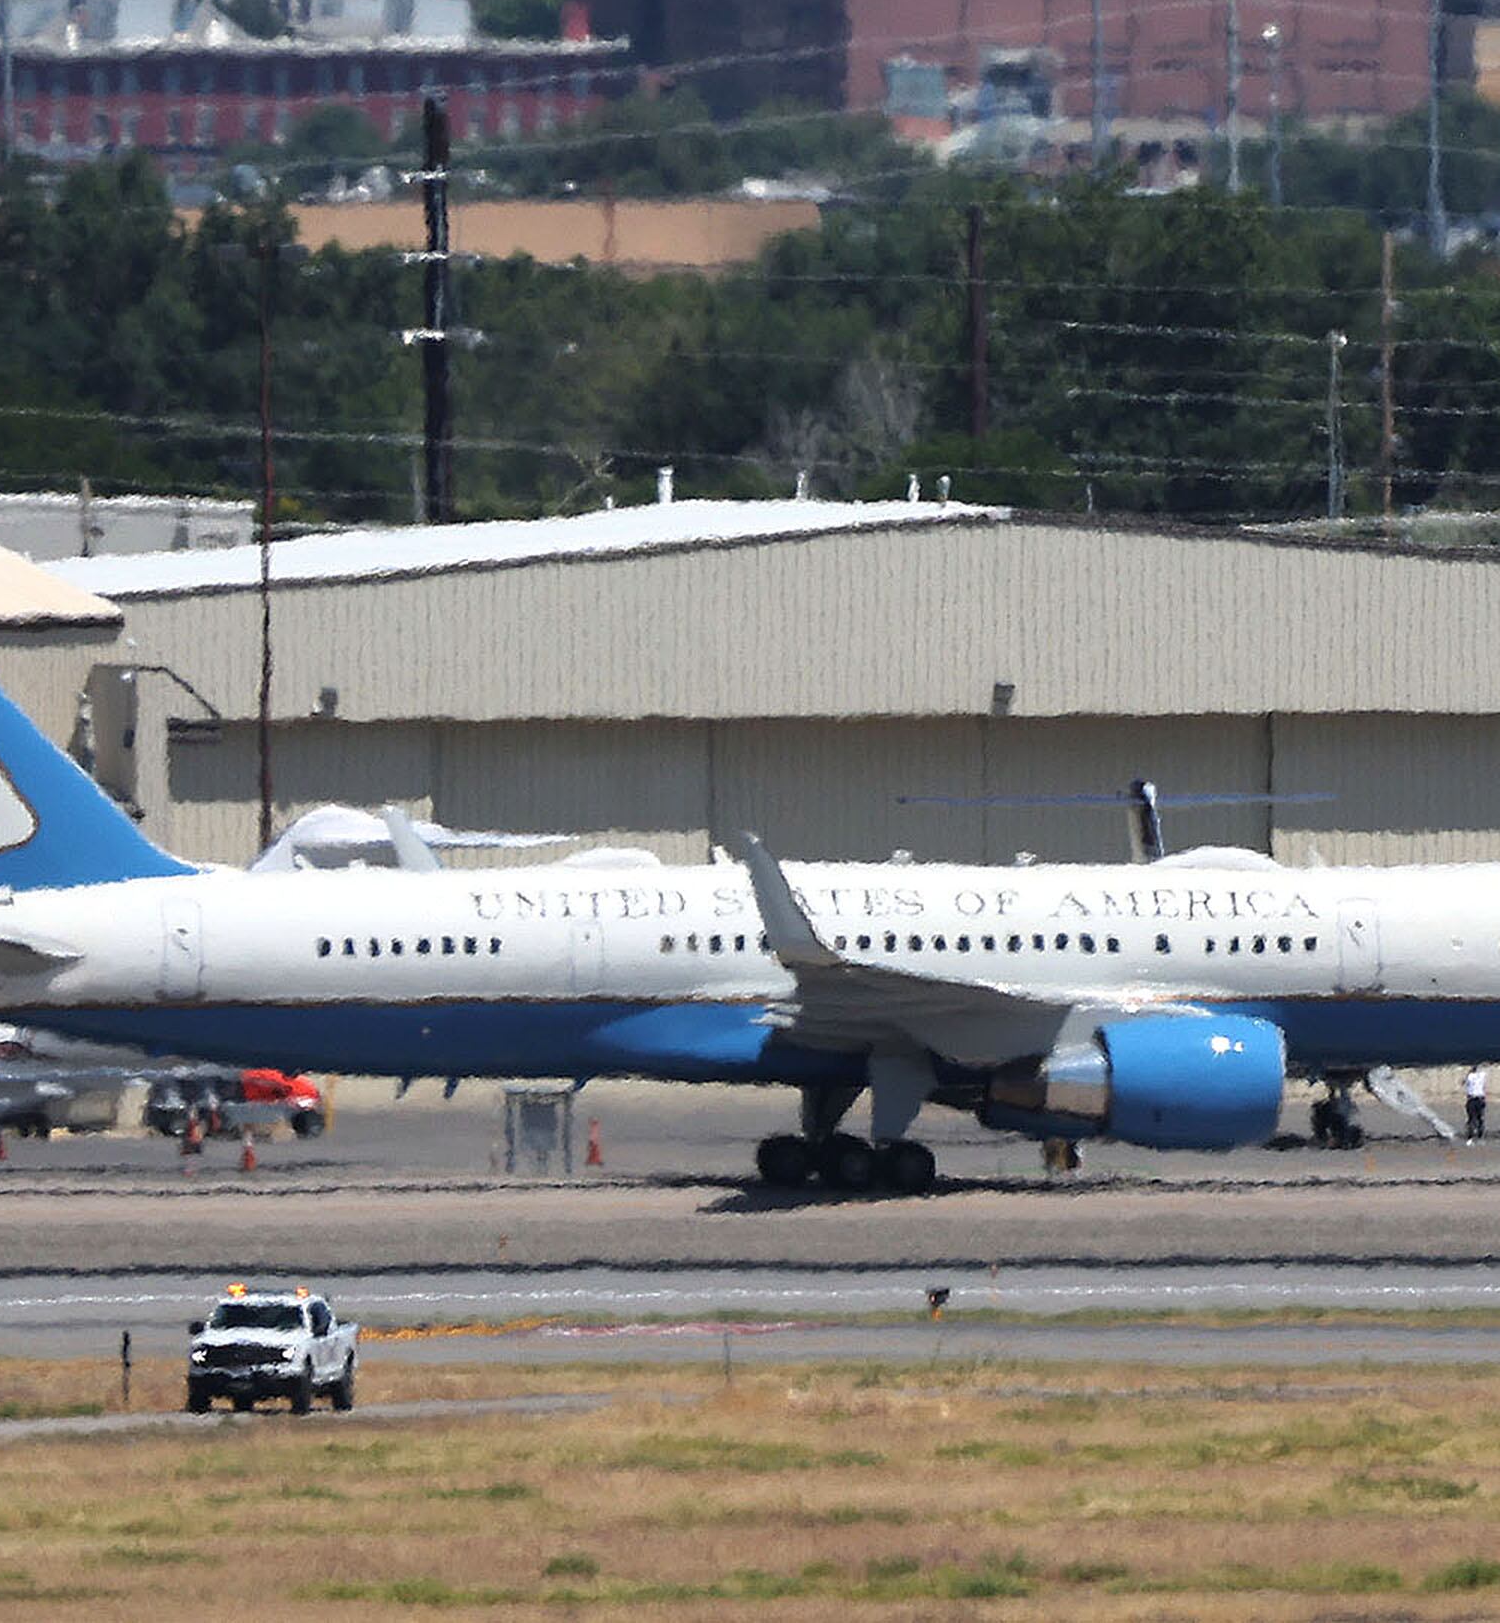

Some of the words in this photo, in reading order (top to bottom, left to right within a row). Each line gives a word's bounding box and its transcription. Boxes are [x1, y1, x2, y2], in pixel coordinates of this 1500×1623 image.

[469, 888, 686, 919] UNITED
[712, 887, 925, 918] SATES
[955, 889, 1019, 918] OF
[1048, 889, 1320, 921] AMERICA
